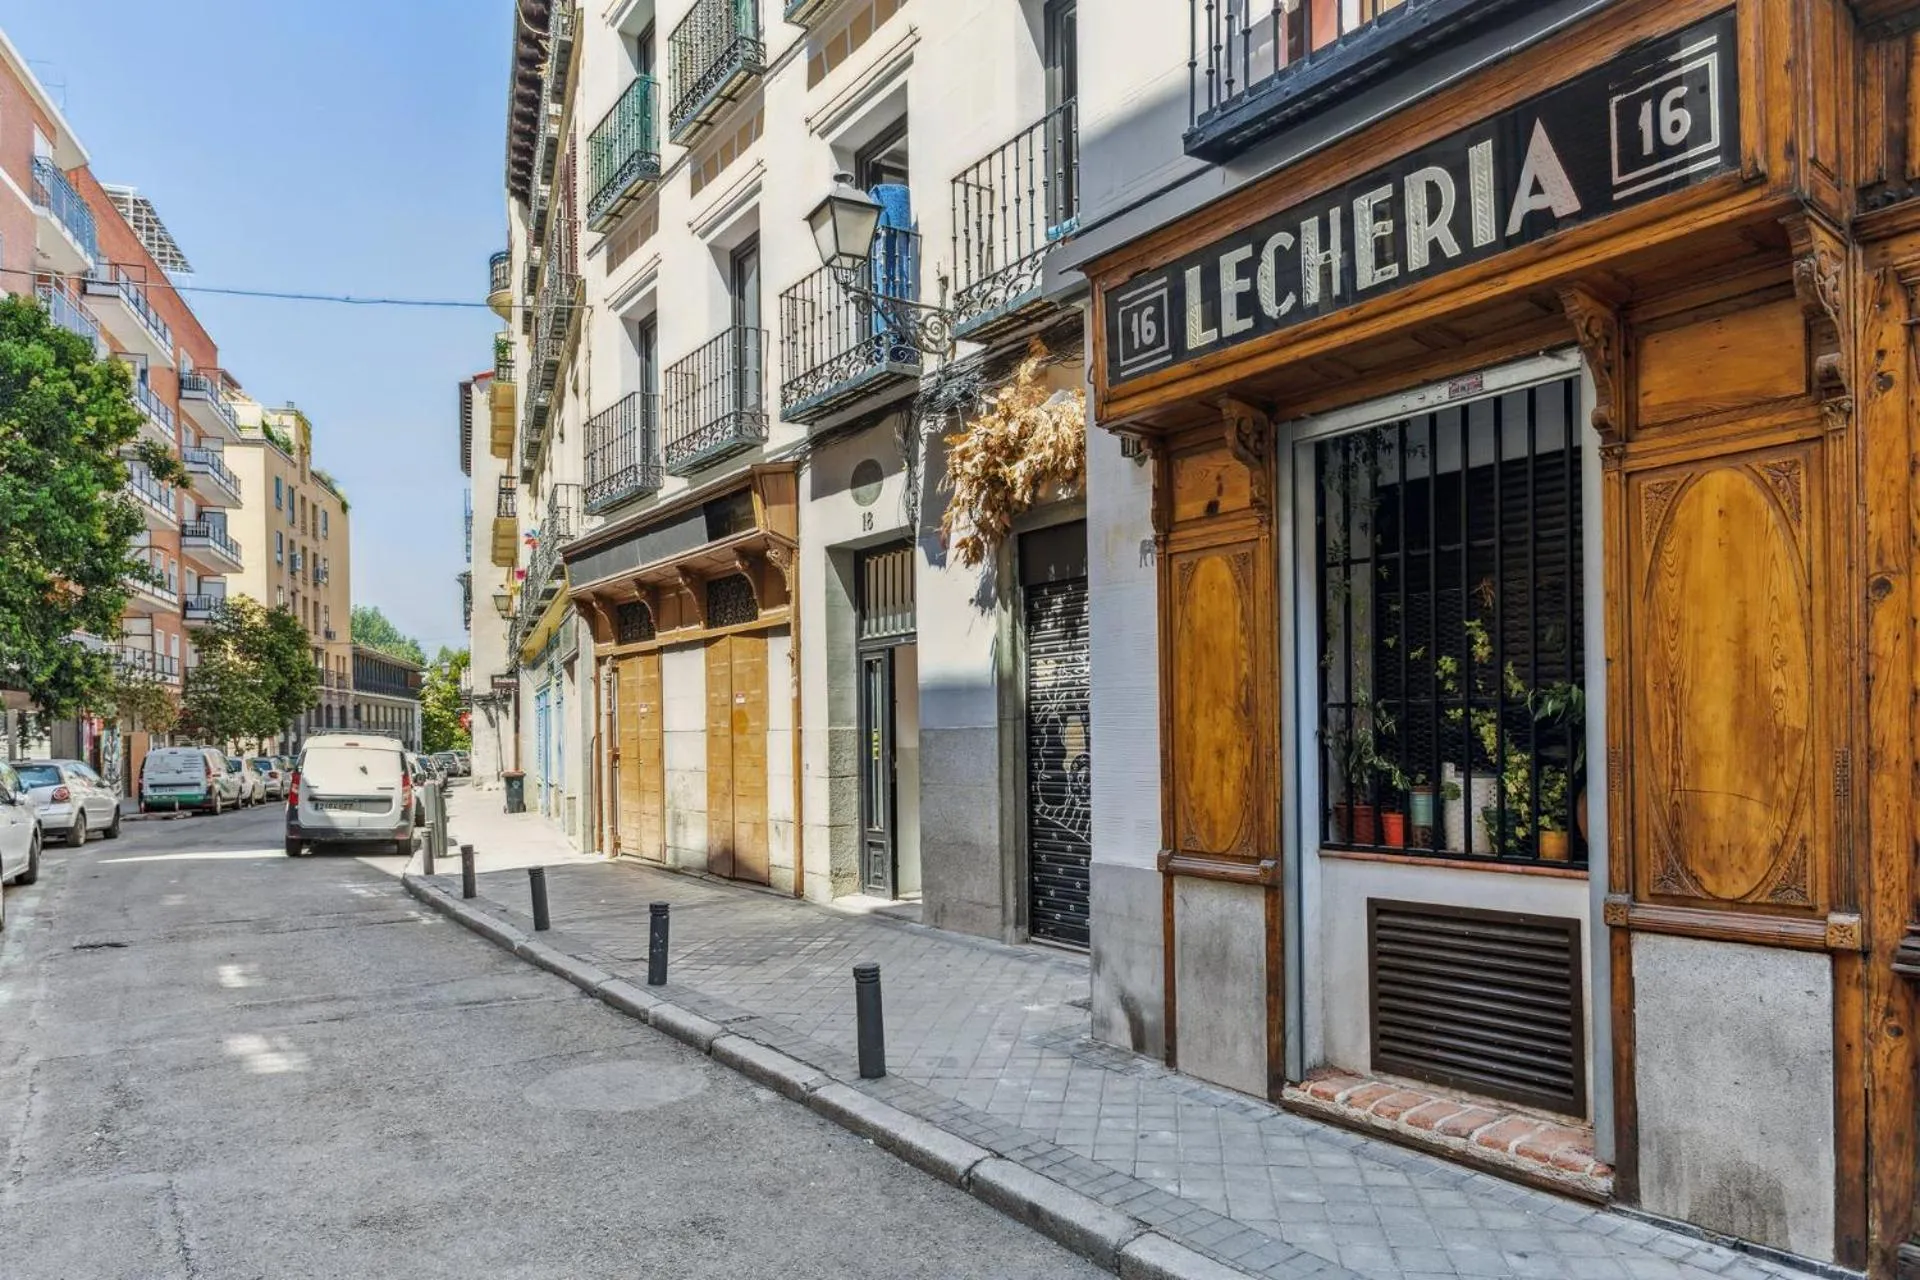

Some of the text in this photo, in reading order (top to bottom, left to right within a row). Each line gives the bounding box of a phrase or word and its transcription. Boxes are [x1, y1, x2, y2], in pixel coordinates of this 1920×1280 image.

[1131, 86, 1692, 350] 16 LECHERIA 16
[862, 511, 874, 532] 18
